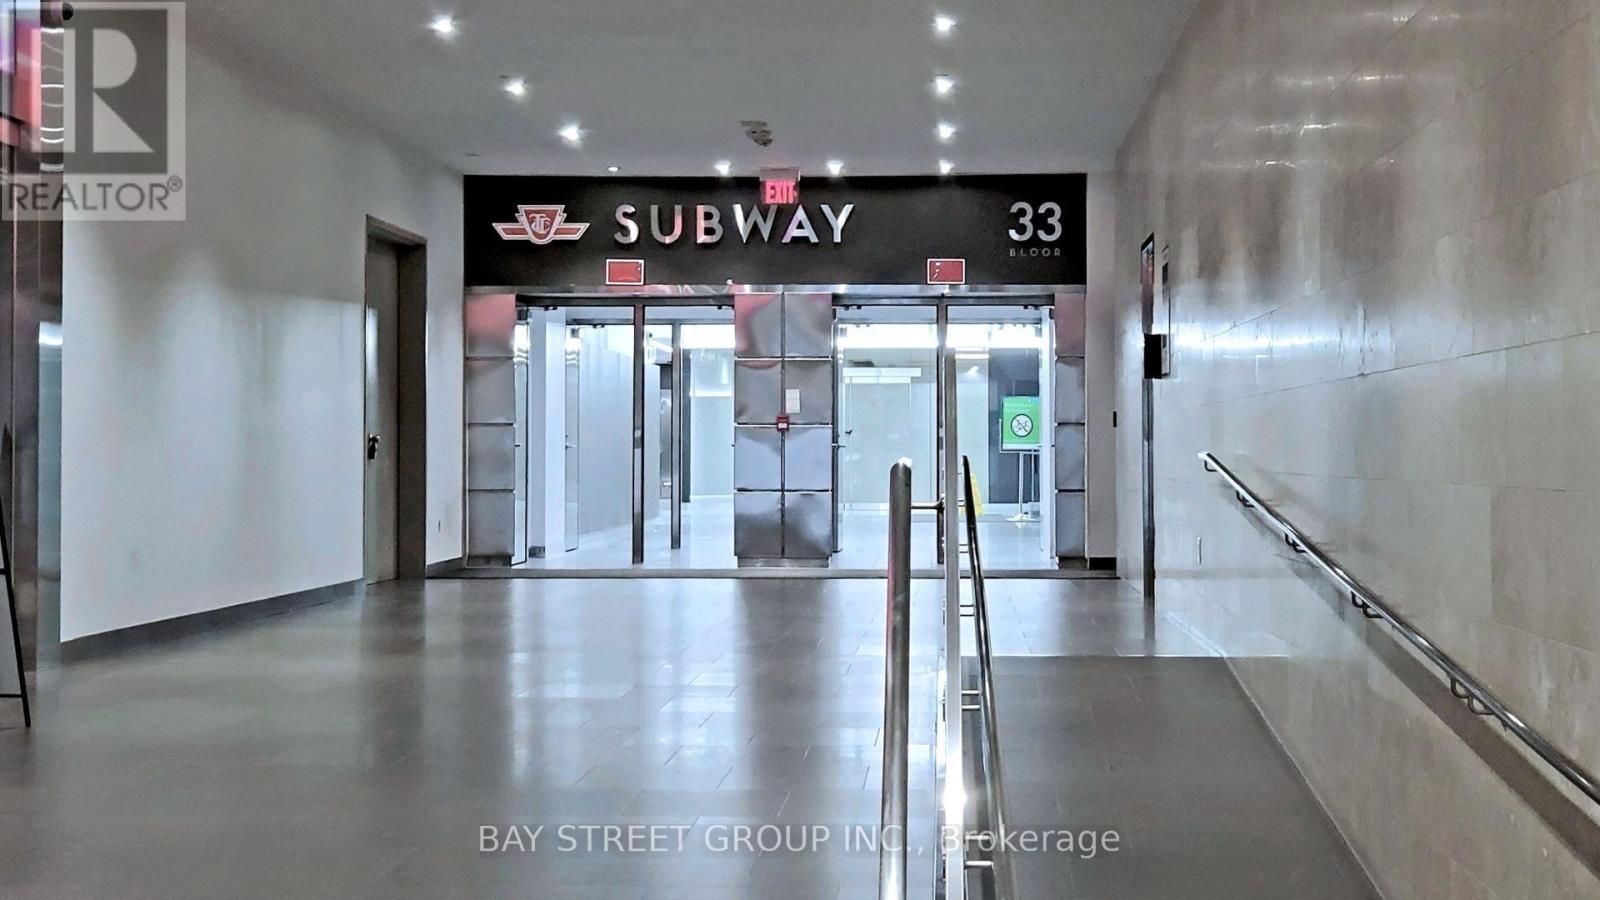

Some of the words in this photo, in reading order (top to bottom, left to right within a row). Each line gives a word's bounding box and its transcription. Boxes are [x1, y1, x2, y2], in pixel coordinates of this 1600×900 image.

[765, 179, 796, 204] EXIT
[614, 203, 855, 245] SUBWAY
[1008, 201, 1063, 242] 33
[1009, 247, 1062, 257] BLOOR
